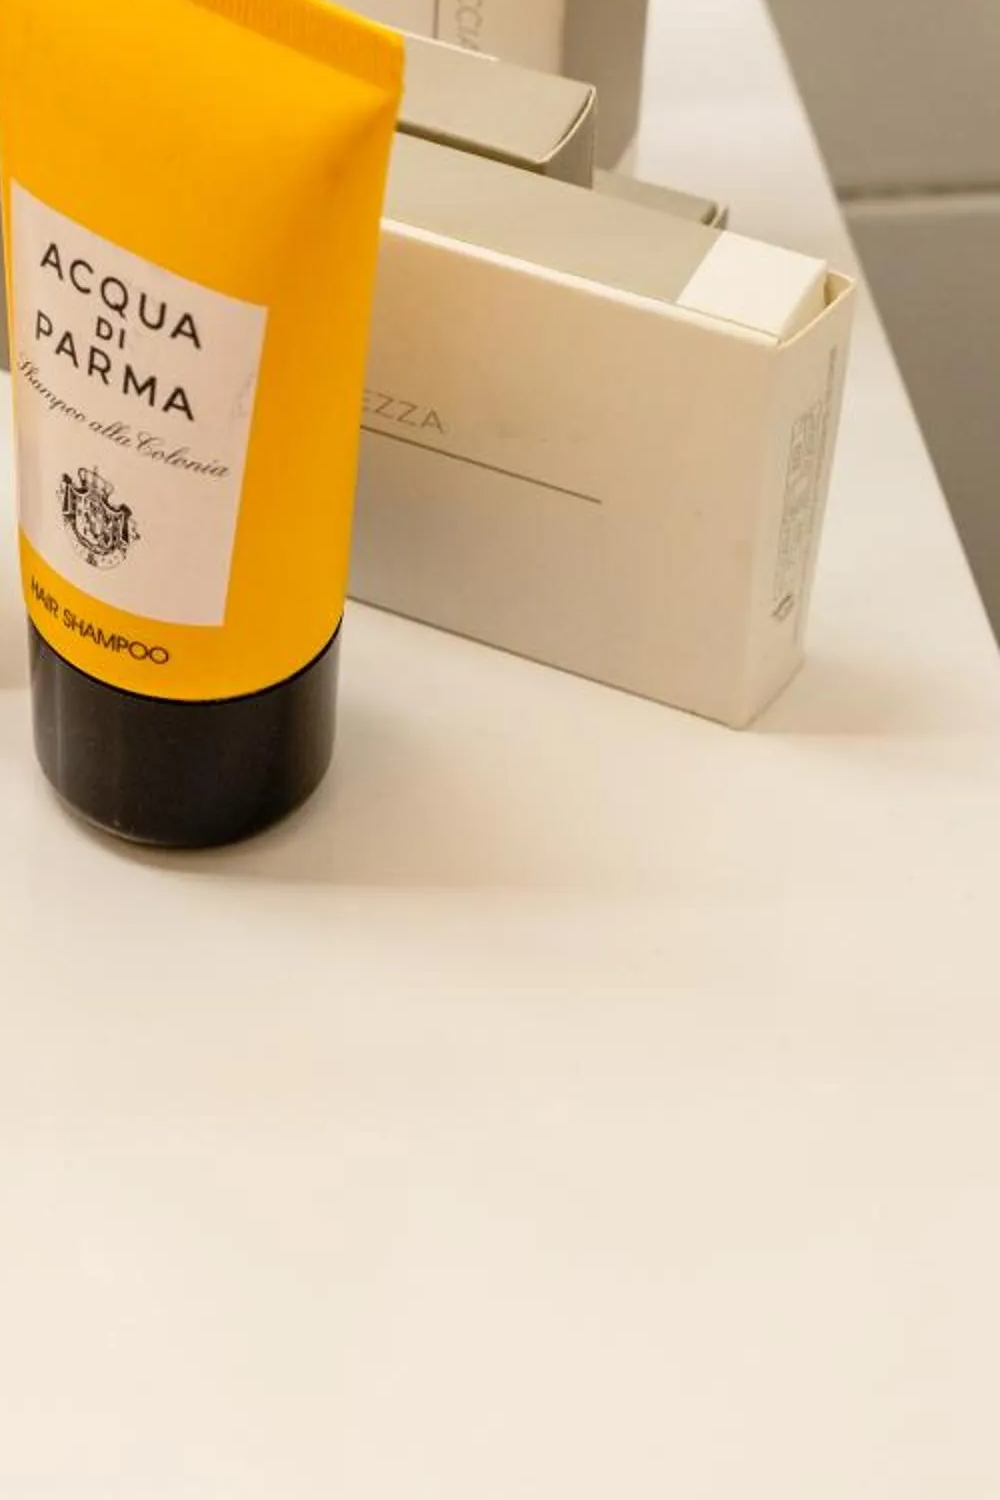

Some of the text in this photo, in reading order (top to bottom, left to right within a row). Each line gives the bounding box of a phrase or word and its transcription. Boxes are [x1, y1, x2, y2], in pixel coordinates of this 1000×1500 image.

[40, 242, 202, 351] ACQUA
[95, 316, 126, 349] DI
[18, 355, 231, 477] Shampoo alla Colonia
[35, 308, 195, 422] PARMA
[31, 575, 169, 665] HAIR SHAMPOO
